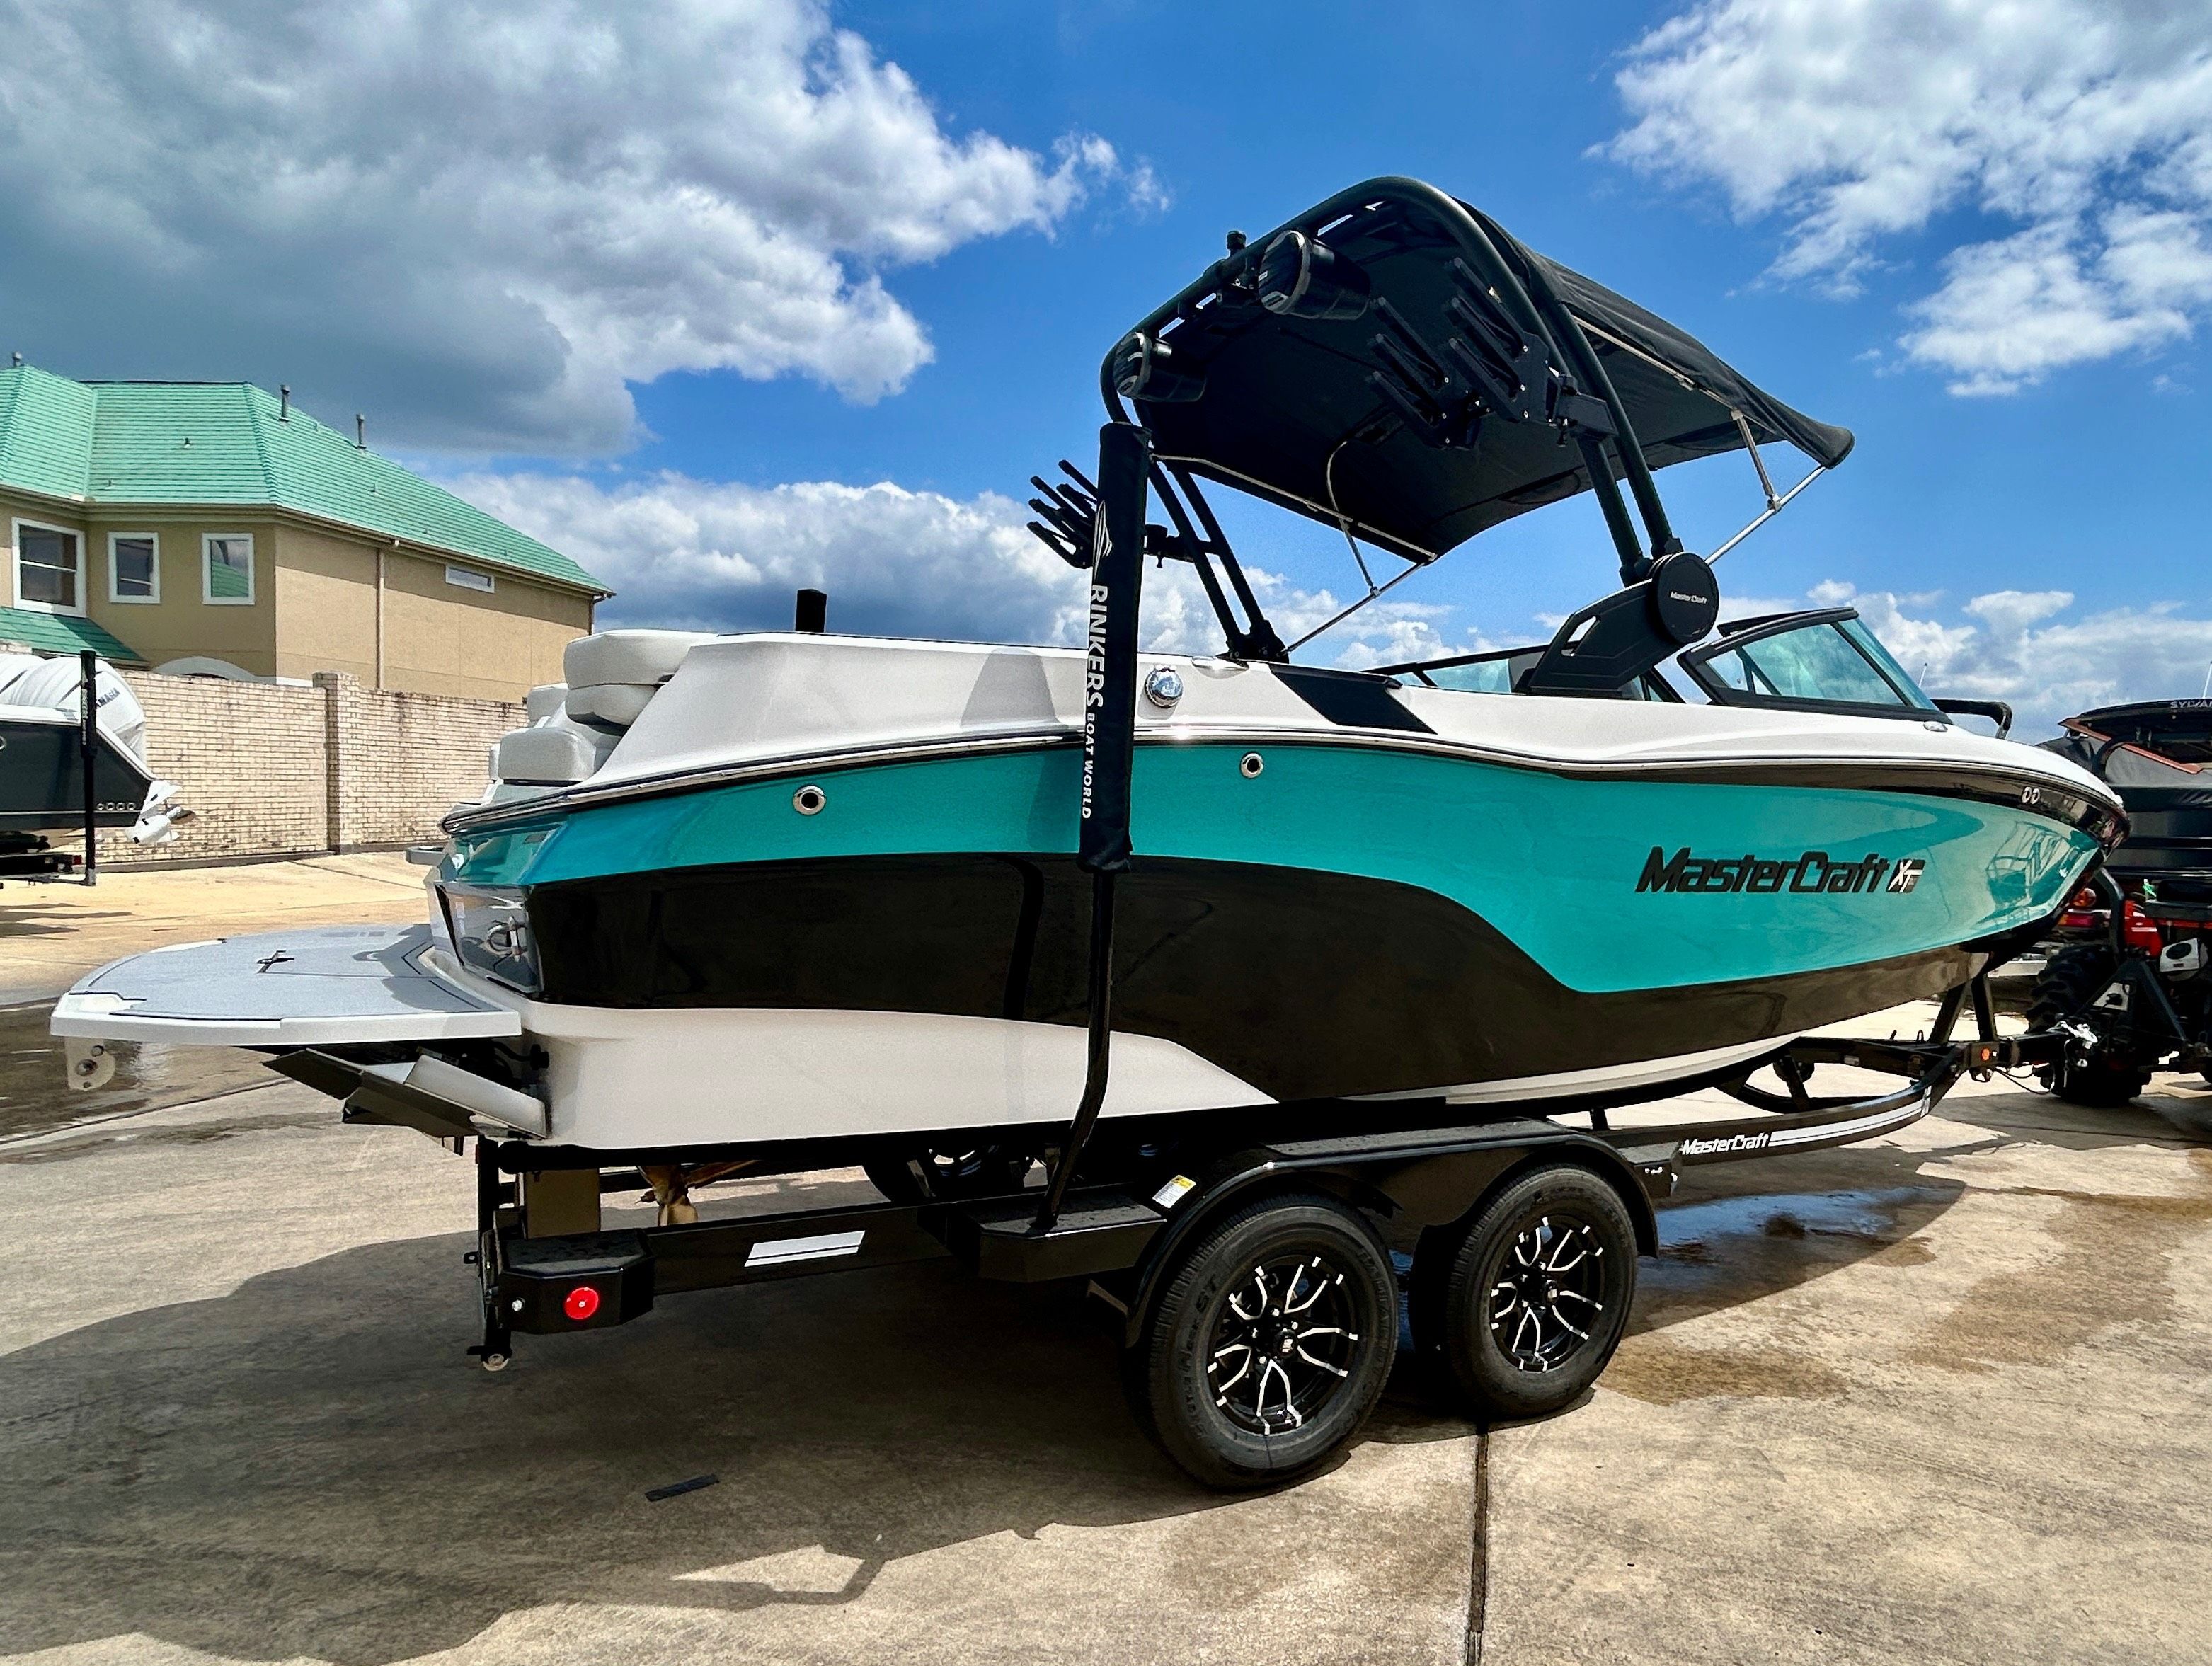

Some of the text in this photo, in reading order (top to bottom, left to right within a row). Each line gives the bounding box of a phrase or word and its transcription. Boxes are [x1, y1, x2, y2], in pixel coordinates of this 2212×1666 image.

[1082, 585, 1108, 819] RINKERS BOAT WORLD
[1635, 846, 1924, 893] MasterCraft XT
[1680, 1132, 1769, 1155] MasterCraft
